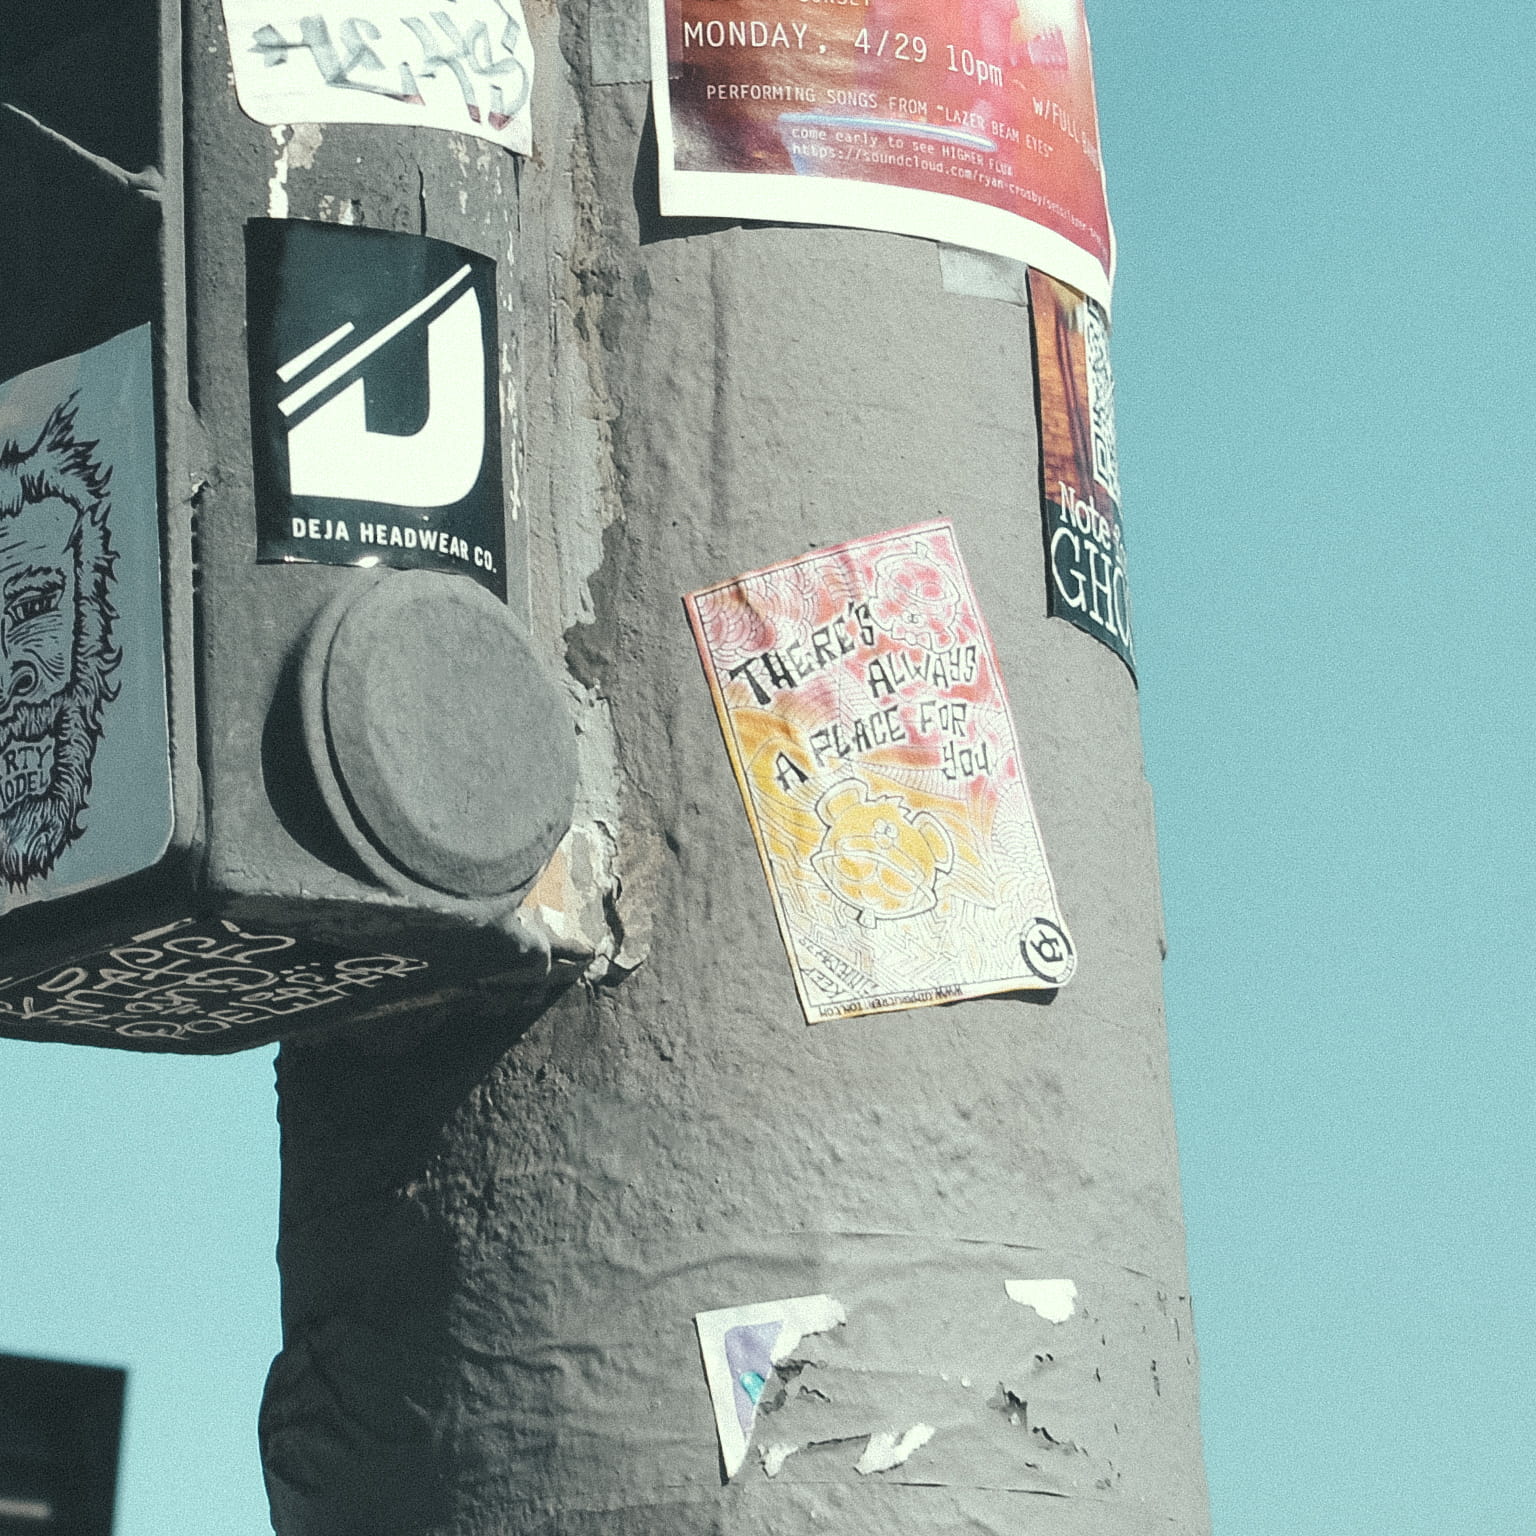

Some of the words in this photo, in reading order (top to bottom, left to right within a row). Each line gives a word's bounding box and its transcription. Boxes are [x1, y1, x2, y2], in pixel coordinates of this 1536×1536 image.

[684, 21, 828, 54] MONDAY,
[854, 27, 928, 64] 4/29
[946, 45, 1004, 87] 10pm
[706, 84, 817, 103] PERFORMING
[827, 89, 879, 110] SONGS
[888, 96, 928, 116] FROM
[991, 121, 1021, 144] BEAM
[791, 128, 827, 142] come
[835, 130, 879, 149] early
[888, 136, 904, 149] to
[912, 141, 935, 155] see
[942, 144, 985, 167] HIGHER
[292, 517, 350, 542] DEJA
[359, 521, 470, 561] HEADWEAR
[473, 545, 497, 574] CO.
[729, 601, 875, 706] THERE'S
[867, 644, 977, 700] ALWAYS
[776, 751, 809, 792] A
[809, 704, 906, 768] PLACE
[919, 699, 967, 738] FOR
